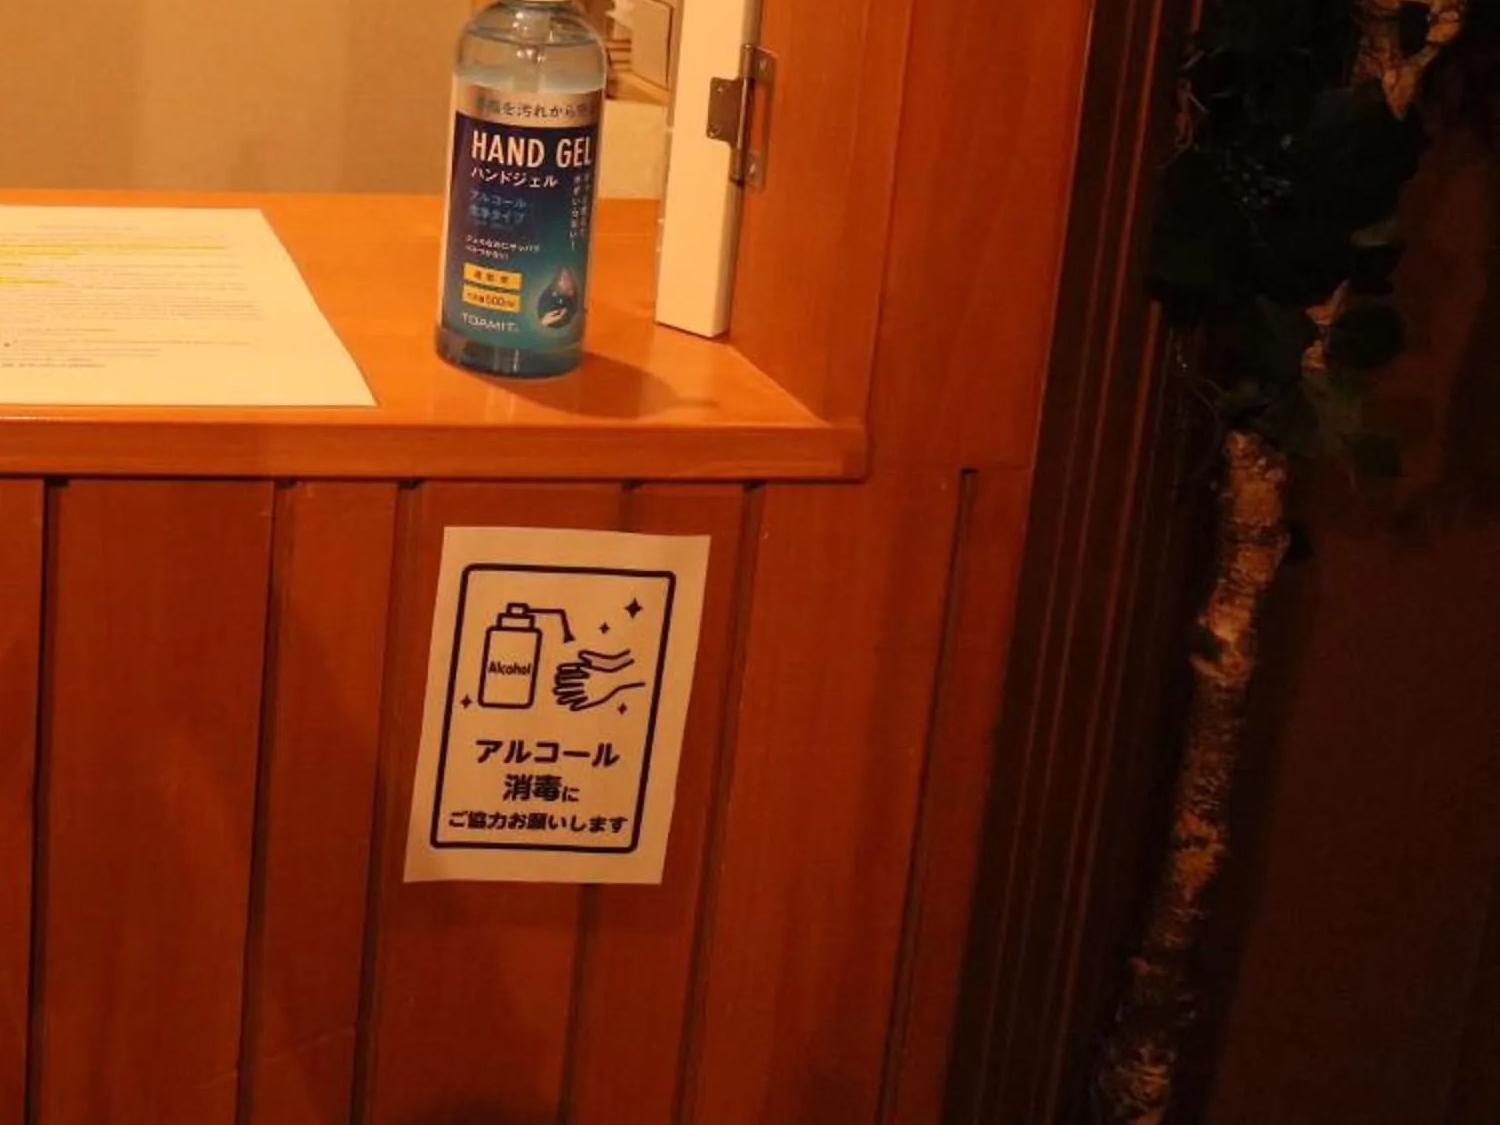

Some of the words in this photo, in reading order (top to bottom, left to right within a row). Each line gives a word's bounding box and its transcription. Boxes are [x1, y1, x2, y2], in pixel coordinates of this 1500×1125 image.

[471, 130, 545, 168] HAND
[556, 136, 592, 168] GEL
[471, 167, 559, 188] ハンドジェル
[487, 660, 532, 676] Alcohol
[475, 739, 620, 768] アルコール
[502, 773, 580, 803] 消毒に
[448, 810, 629, 834] ご協力お願いします
